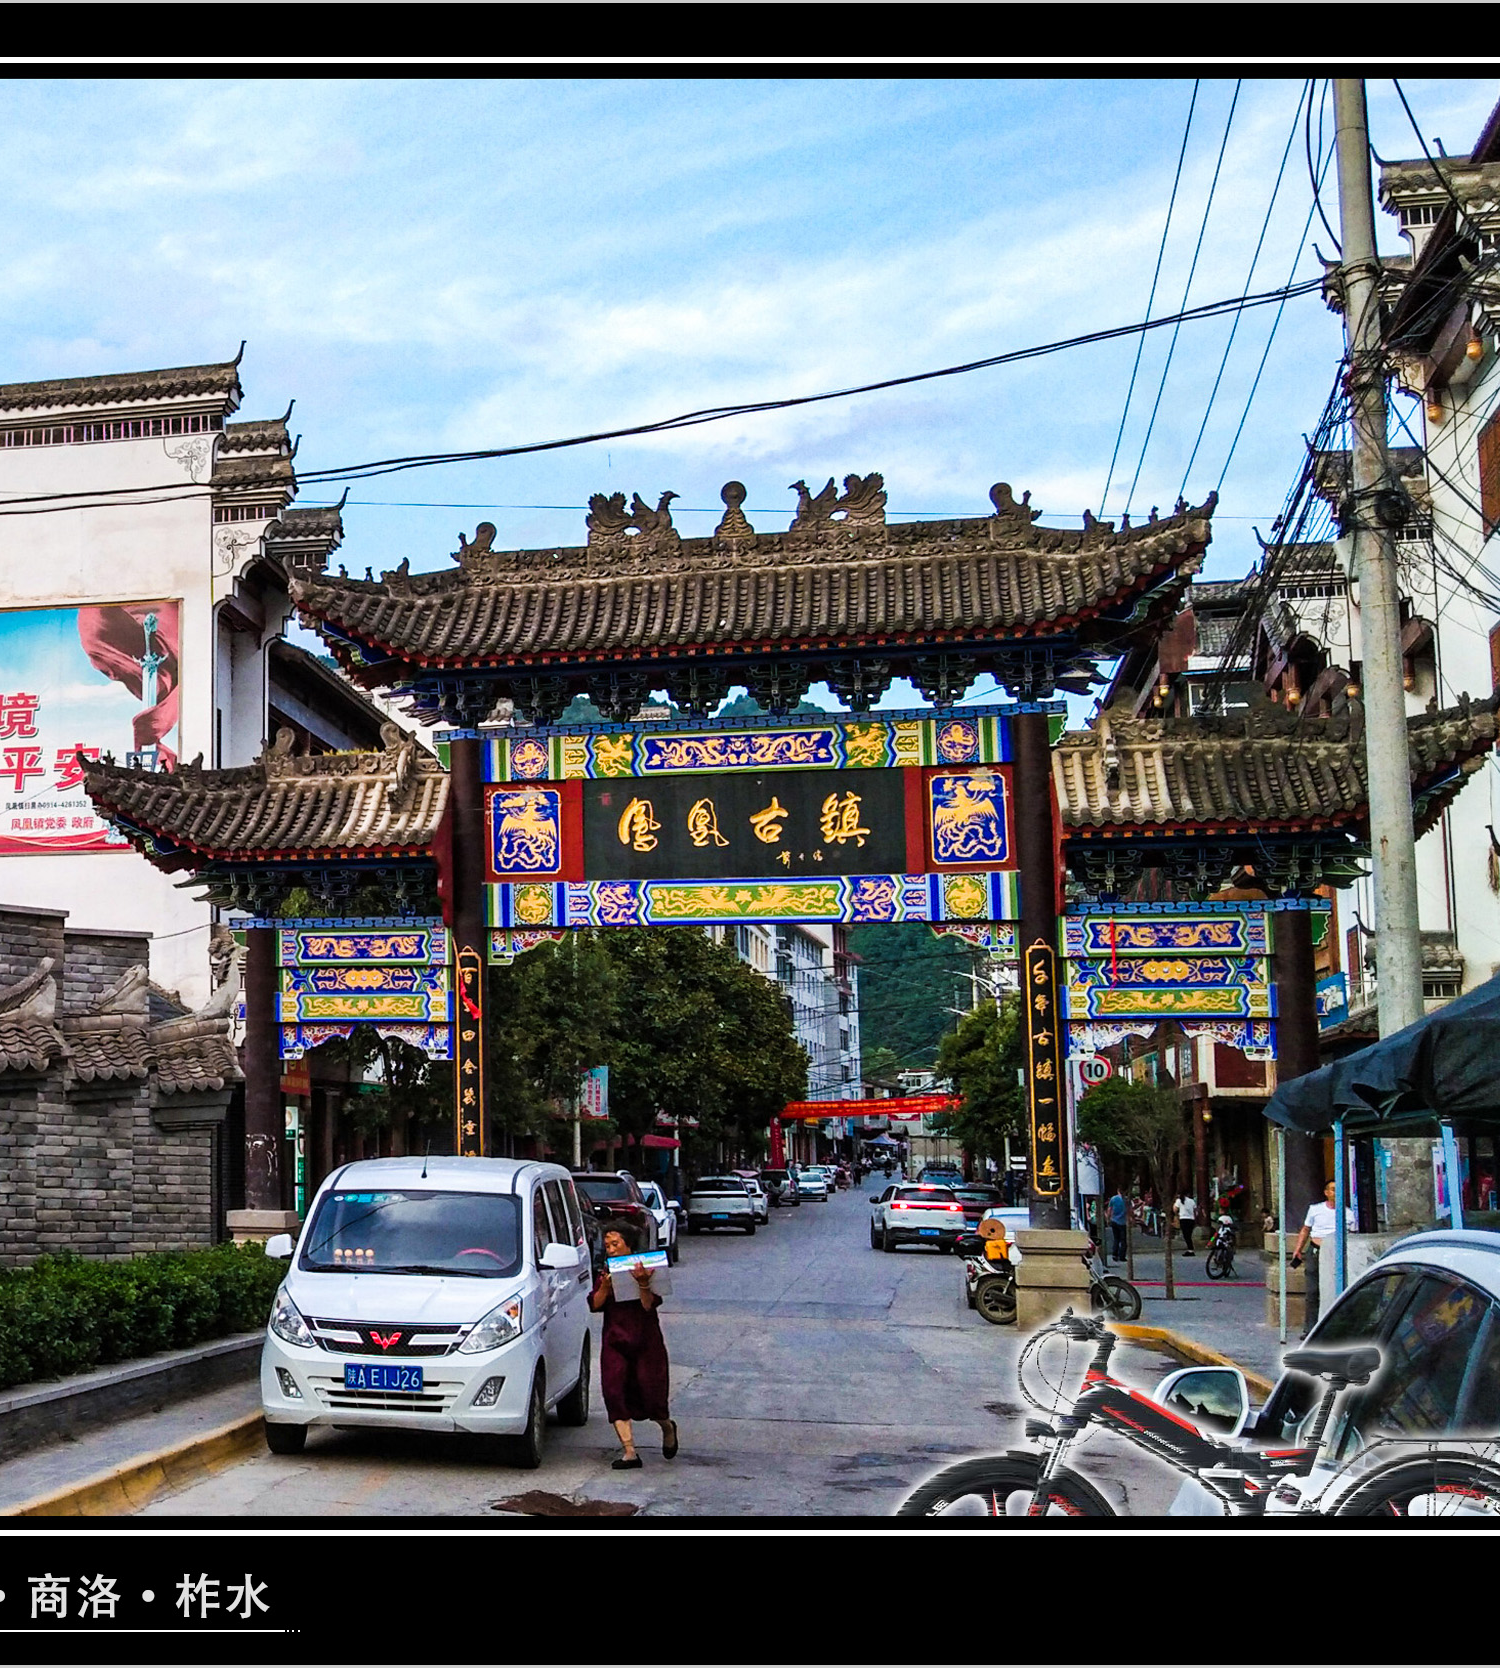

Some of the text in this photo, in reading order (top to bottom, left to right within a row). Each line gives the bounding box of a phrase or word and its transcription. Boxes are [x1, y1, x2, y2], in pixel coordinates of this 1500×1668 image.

[11, 816, 95, 831] 凤凰镇党委 政府
[1086, 1063, 1104, 1078] 10
